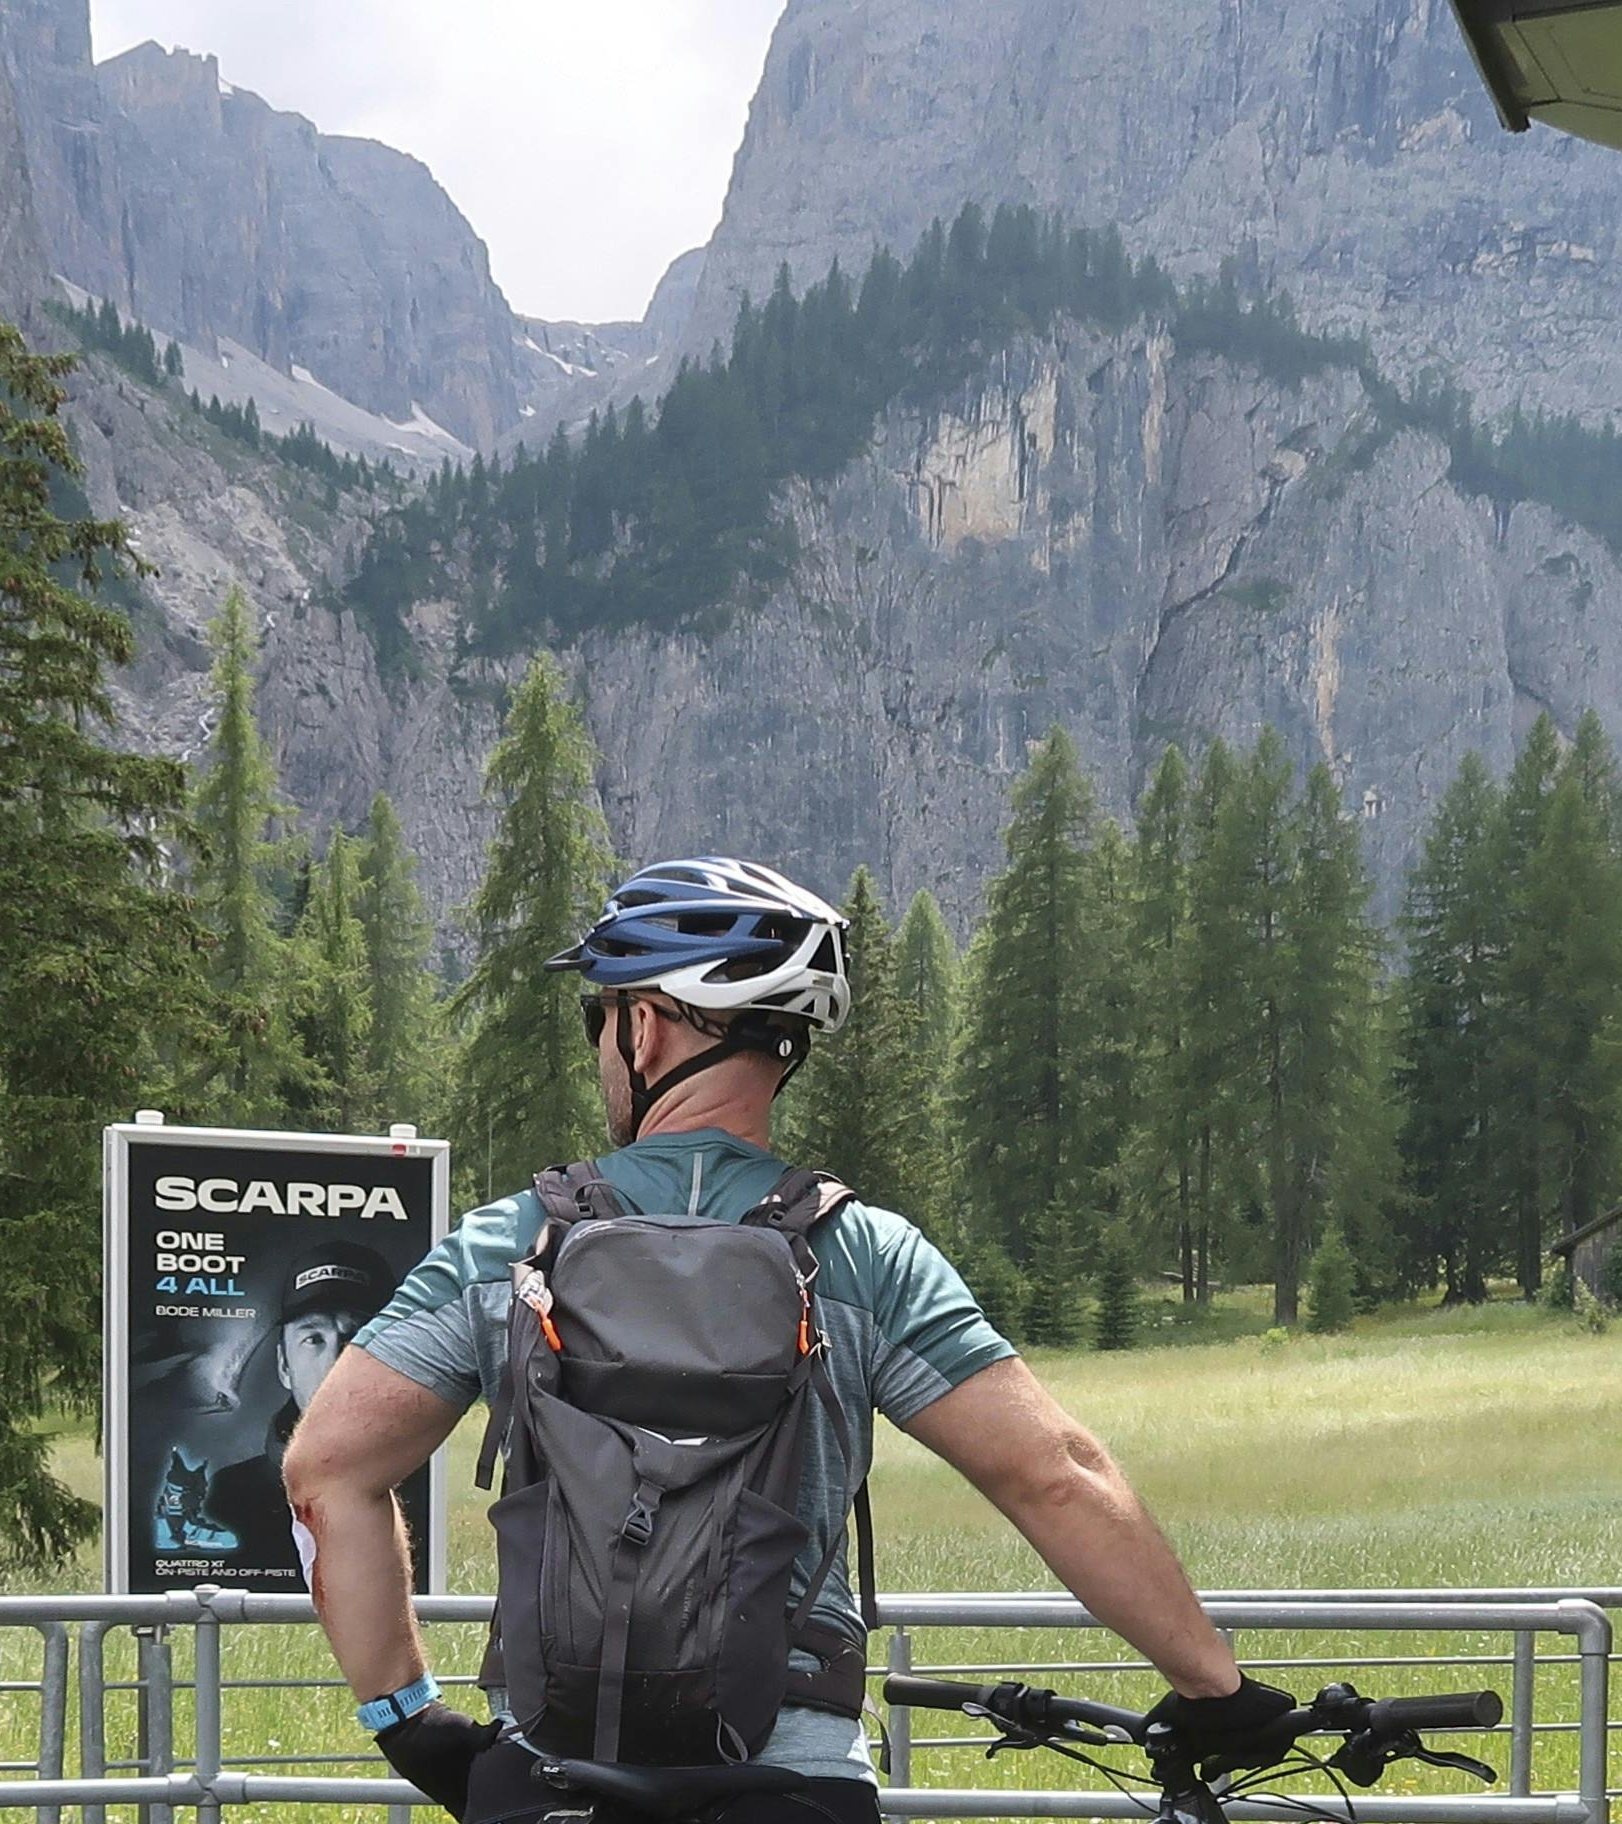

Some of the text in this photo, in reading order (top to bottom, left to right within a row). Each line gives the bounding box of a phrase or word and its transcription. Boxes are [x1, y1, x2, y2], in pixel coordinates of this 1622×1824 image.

[155, 1176, 408, 1220] SCARPA
[156, 1231, 224, 1251] ONE
[156, 1253, 246, 1274] BOOT
[297, 1266, 369, 1285] SCARPA
[156, 1276, 245, 1296] 4 ALL
[155, 1305, 256, 1319] BODE MILLER
[155, 1559, 225, 1568] QUATTRO XT
[155, 1568, 296, 1577] ON-PISTE AND OFF-PISTE
